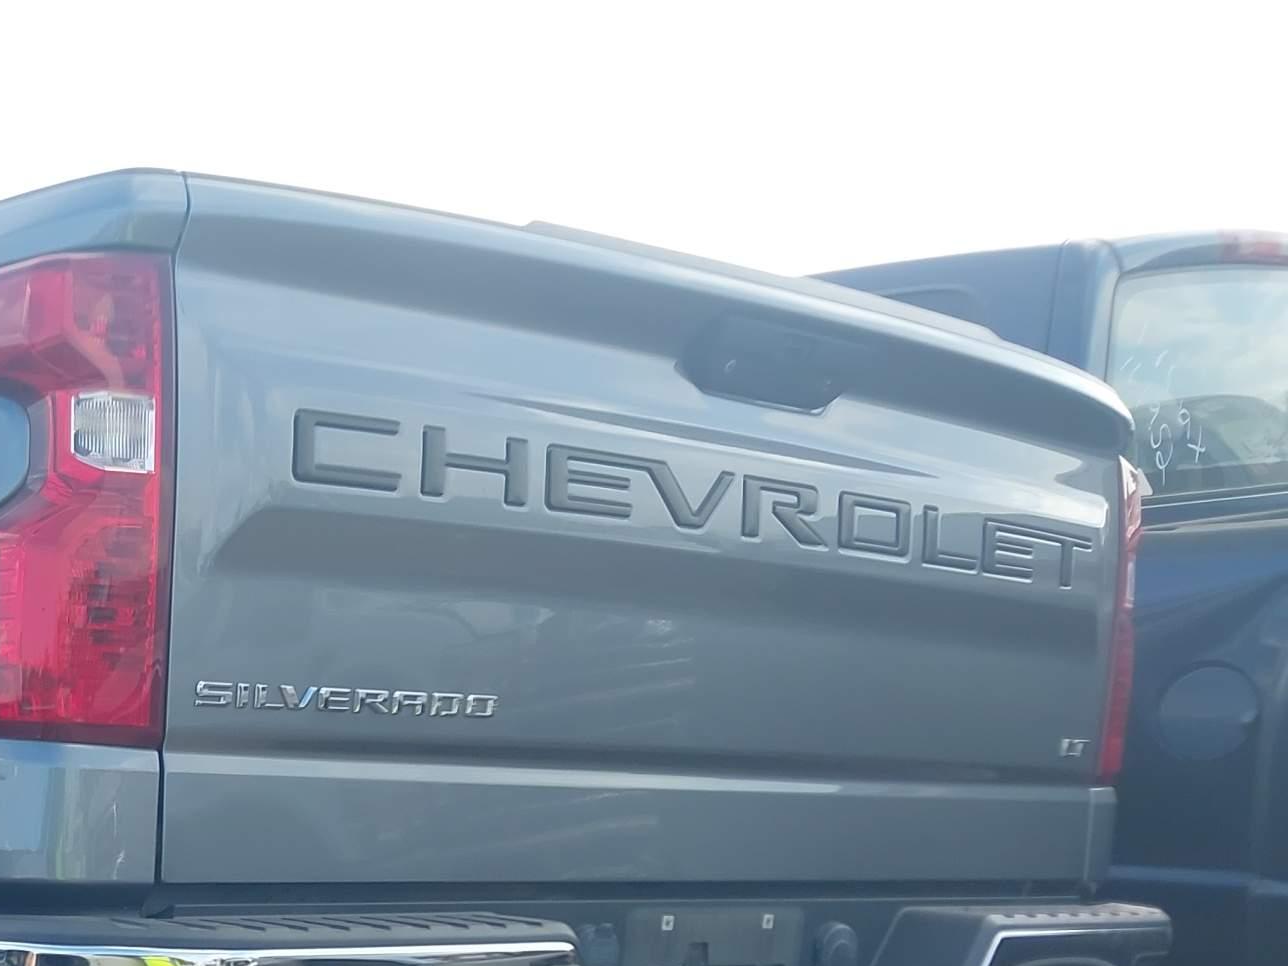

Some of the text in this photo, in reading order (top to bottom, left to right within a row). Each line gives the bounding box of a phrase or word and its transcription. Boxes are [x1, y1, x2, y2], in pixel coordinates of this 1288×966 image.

[292, 408, 1094, 590] CHEVROLET
[194, 679, 499, 717] SILVERADO
[1060, 738, 1092, 758] LT
